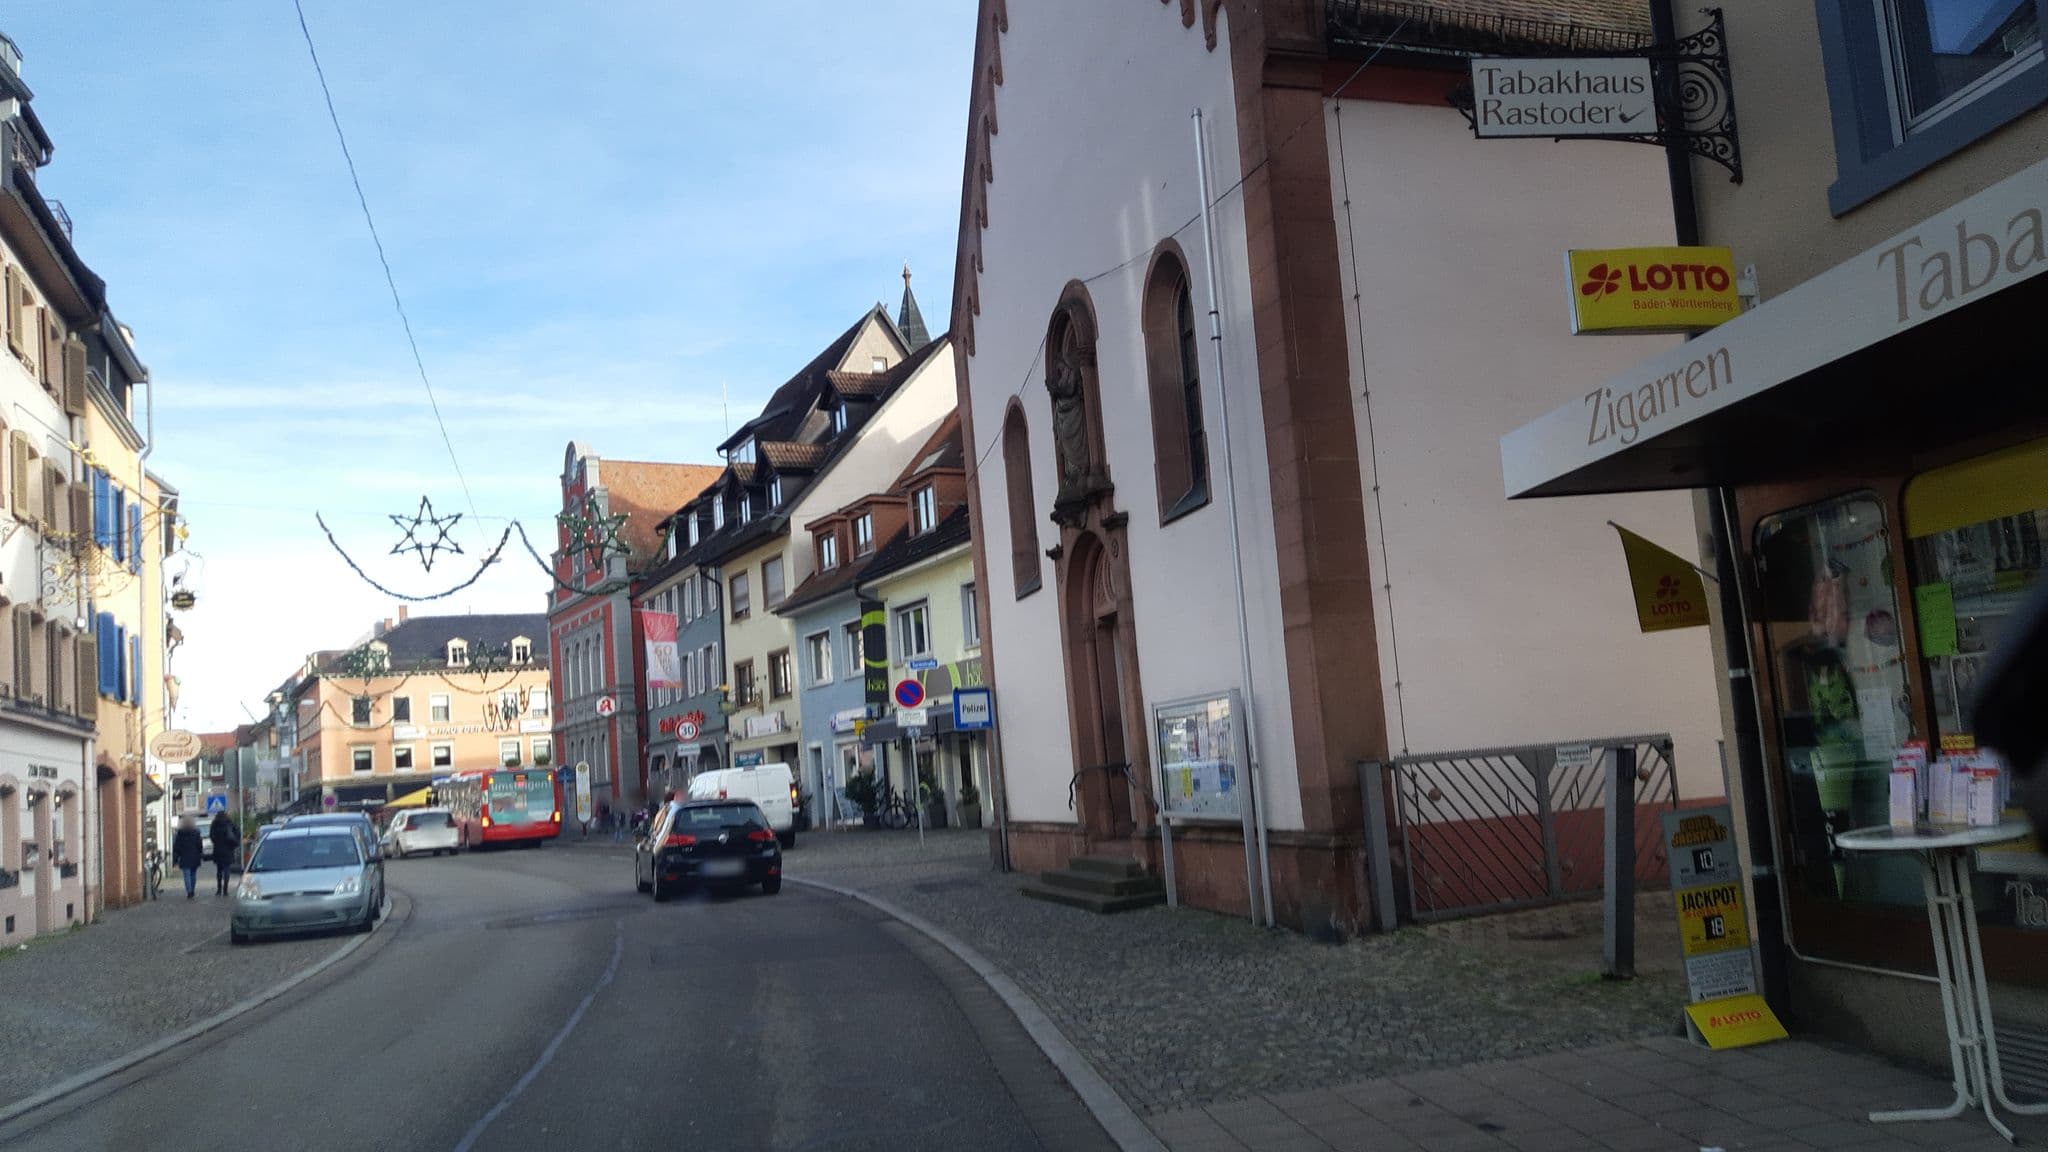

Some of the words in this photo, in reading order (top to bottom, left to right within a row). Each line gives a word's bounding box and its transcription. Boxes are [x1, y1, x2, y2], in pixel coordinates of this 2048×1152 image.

[1479, 68, 1645, 96] Tabakhaus
[1482, 99, 1615, 126] Rastoder
[1877, 208, 2048, 323] Taba
[1628, 264, 1730, 292] LOTTO
[1633, 299, 1733, 313] Baden-Württemberg
[1584, 347, 1733, 446] Zigarren
[1651, 600, 1691, 616] LOTTO
[961, 703, 986, 713] Polizei
[681, 725, 694, 736] 30
[1681, 885, 1737, 912] JACKPOT
[1710, 917, 1724, 937] 18
[1722, 1010, 1761, 1025] LOTTO
